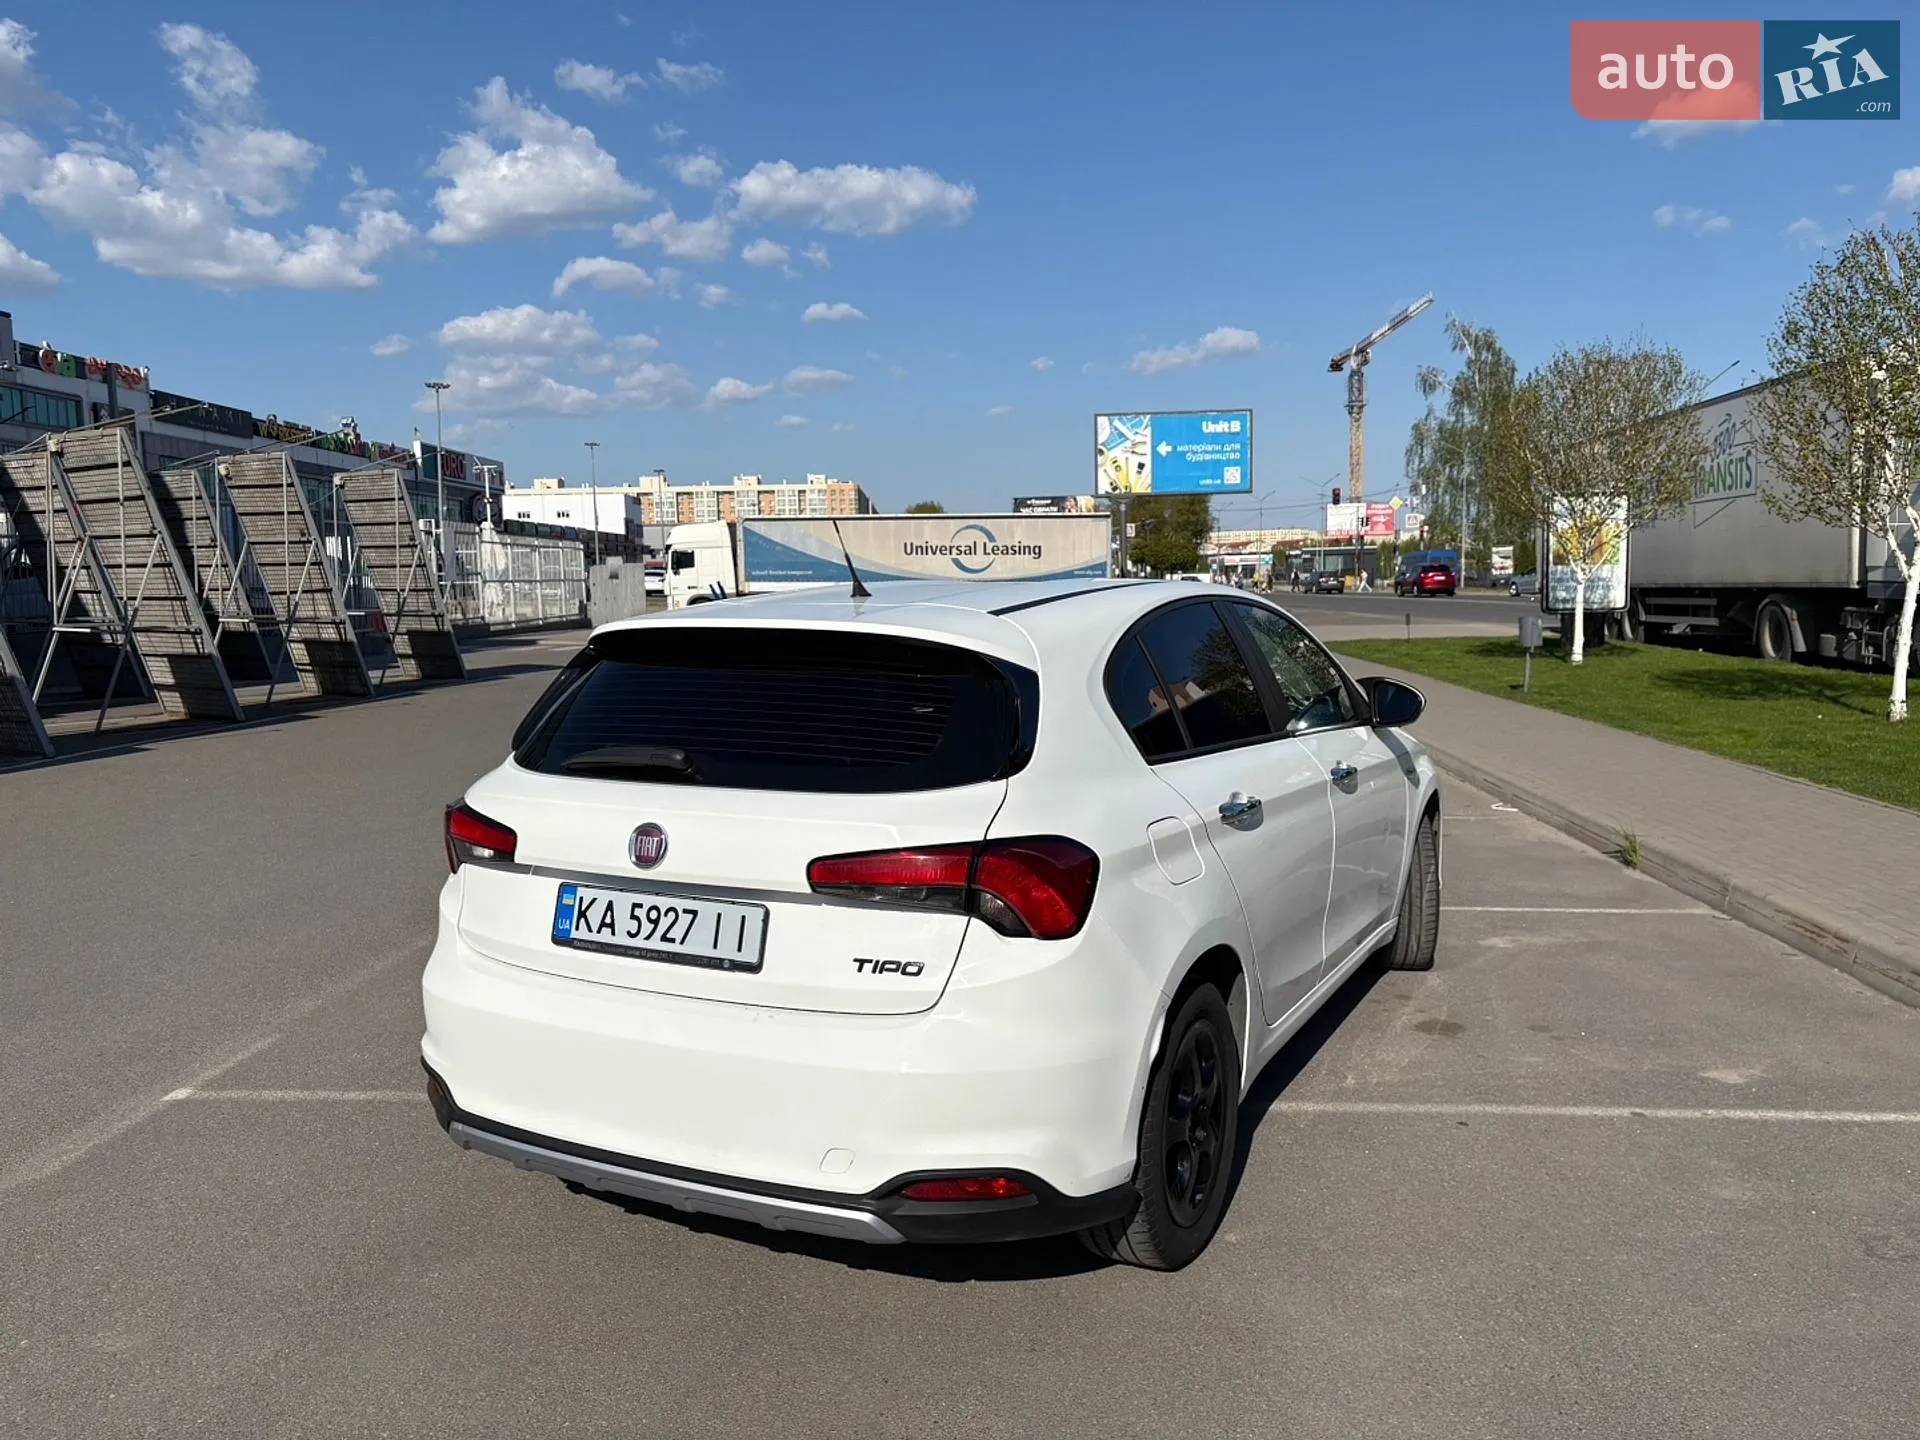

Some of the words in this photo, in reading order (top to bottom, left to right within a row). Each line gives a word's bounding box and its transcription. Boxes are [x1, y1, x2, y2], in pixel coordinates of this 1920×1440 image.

[1223, 443, 1241, 451] для
[904, 541, 977, 556] Universal
[983, 541, 1042, 560] Leasing
[636, 835, 660, 857] FIAT
[558, 917, 571, 931] UA
[575, 896, 617, 937] KA
[626, 902, 699, 945] 5927
[852, 957, 925, 977] TIPO
